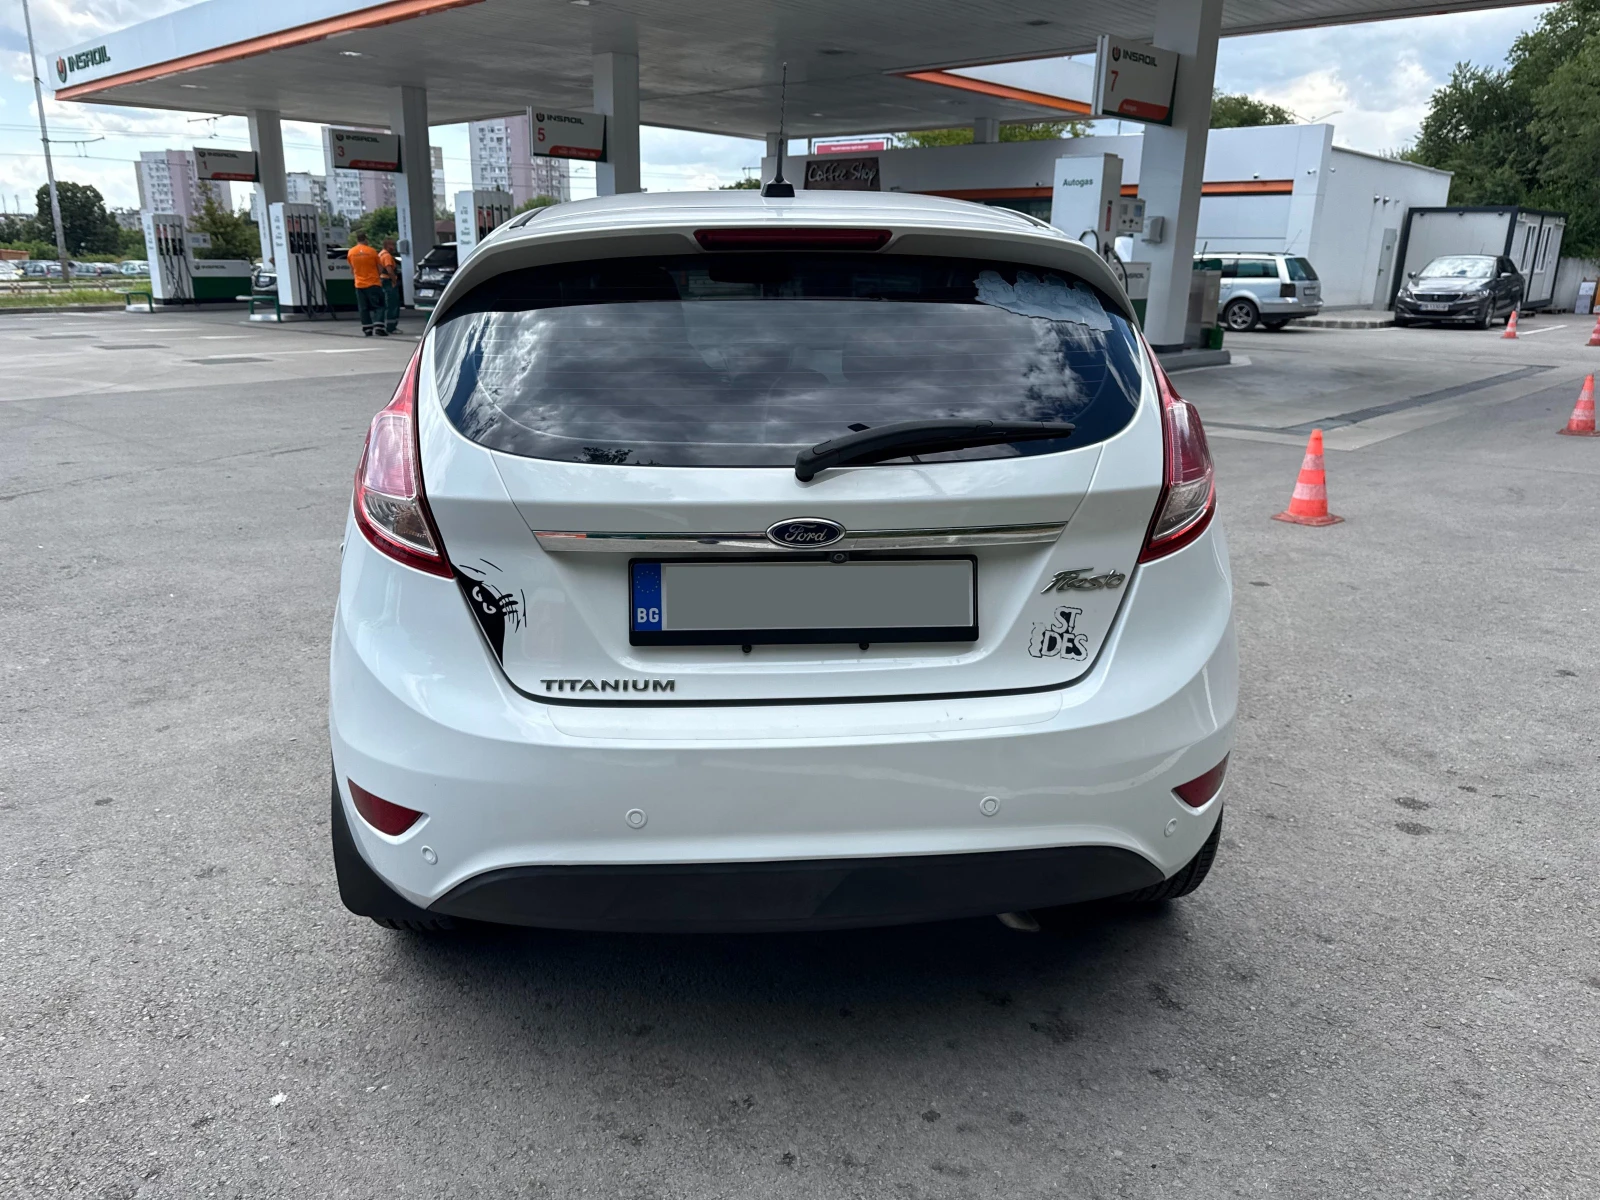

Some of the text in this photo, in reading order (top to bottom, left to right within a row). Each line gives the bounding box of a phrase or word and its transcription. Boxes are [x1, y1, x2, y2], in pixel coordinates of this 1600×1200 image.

[67, 45, 111, 72] INSAOIL
[1123, 49, 1157, 67] INSAOIL
[1111, 69, 1119, 92] 7
[547, 114, 584, 125] INSAOIL
[537, 127, 546, 142] 5
[337, 145, 345, 157] 3
[202, 160, 208, 170] 1
[808, 162, 877, 187] Coffee Shop
[1062, 178, 1094, 188] Autogas
[784, 523, 828, 542] Ford
[1041, 567, 1126, 594] Fiesta
[637, 607, 660, 623] BG
[540, 679, 675, 692] TITANIUM
